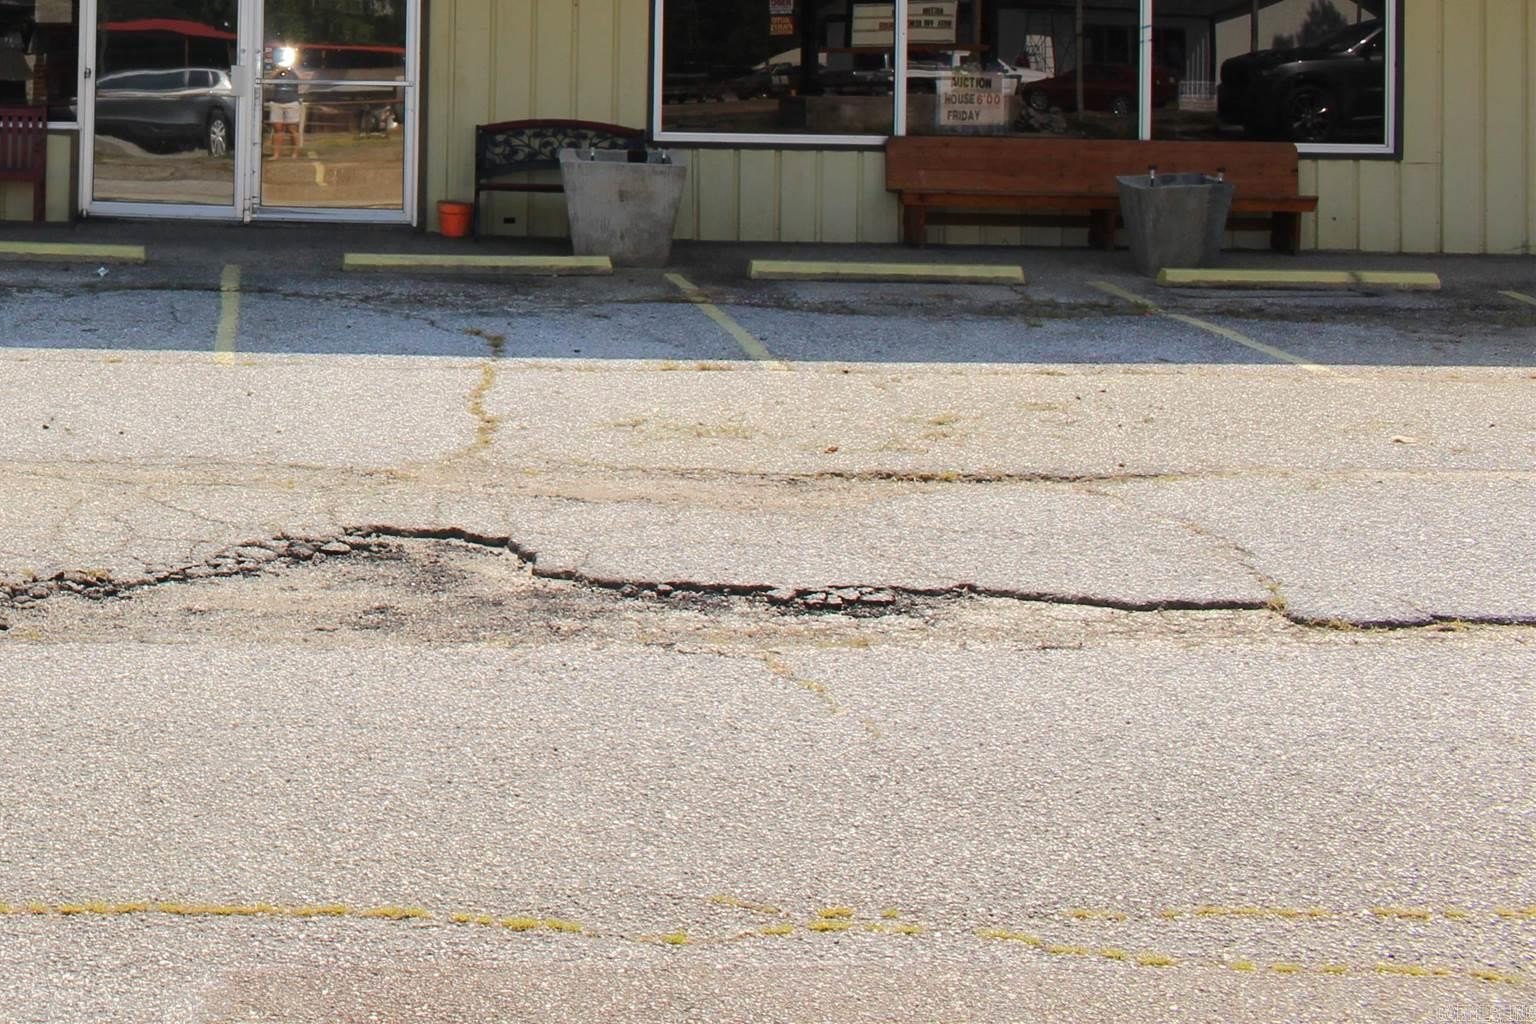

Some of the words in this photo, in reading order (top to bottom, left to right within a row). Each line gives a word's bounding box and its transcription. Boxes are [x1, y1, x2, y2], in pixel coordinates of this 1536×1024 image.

[951, 77, 992, 89] AUCTION
[944, 93, 975, 105] HOUSE
[947, 110, 980, 121] FRIDAY
